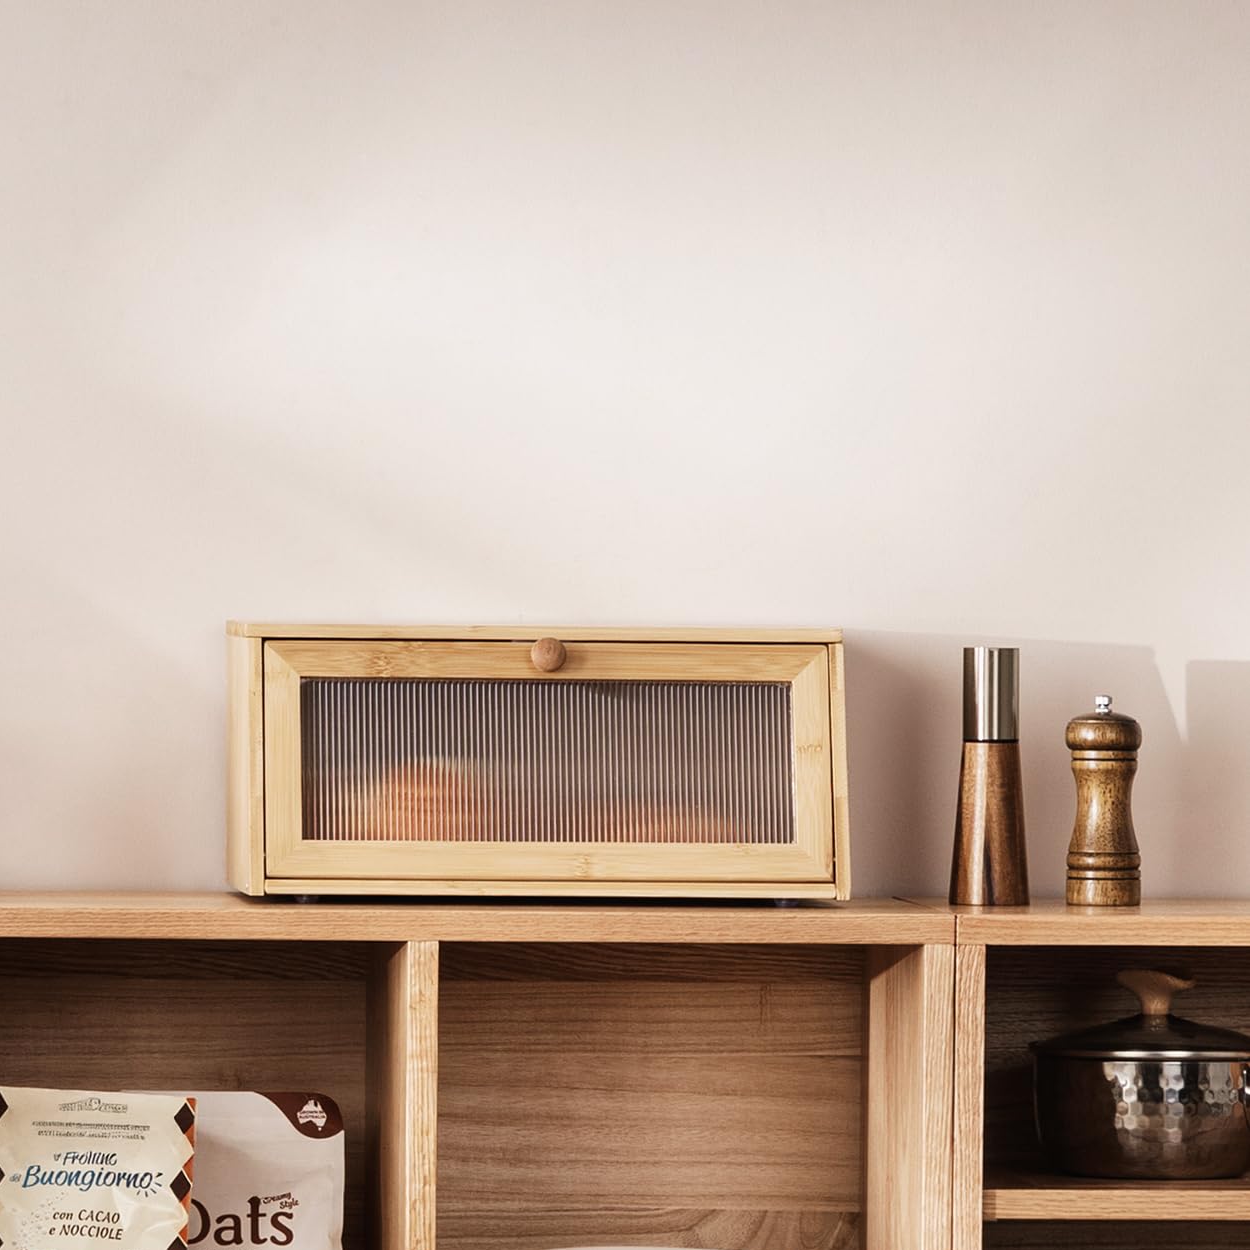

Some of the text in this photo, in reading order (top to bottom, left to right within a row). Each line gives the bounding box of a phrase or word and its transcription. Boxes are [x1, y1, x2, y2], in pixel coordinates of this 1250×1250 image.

[22, 1164, 153, 1192] Buongiorno
[52, 1209, 120, 1225] con CACAO
[48, 1224, 124, 1241] e NOCCIOLE
